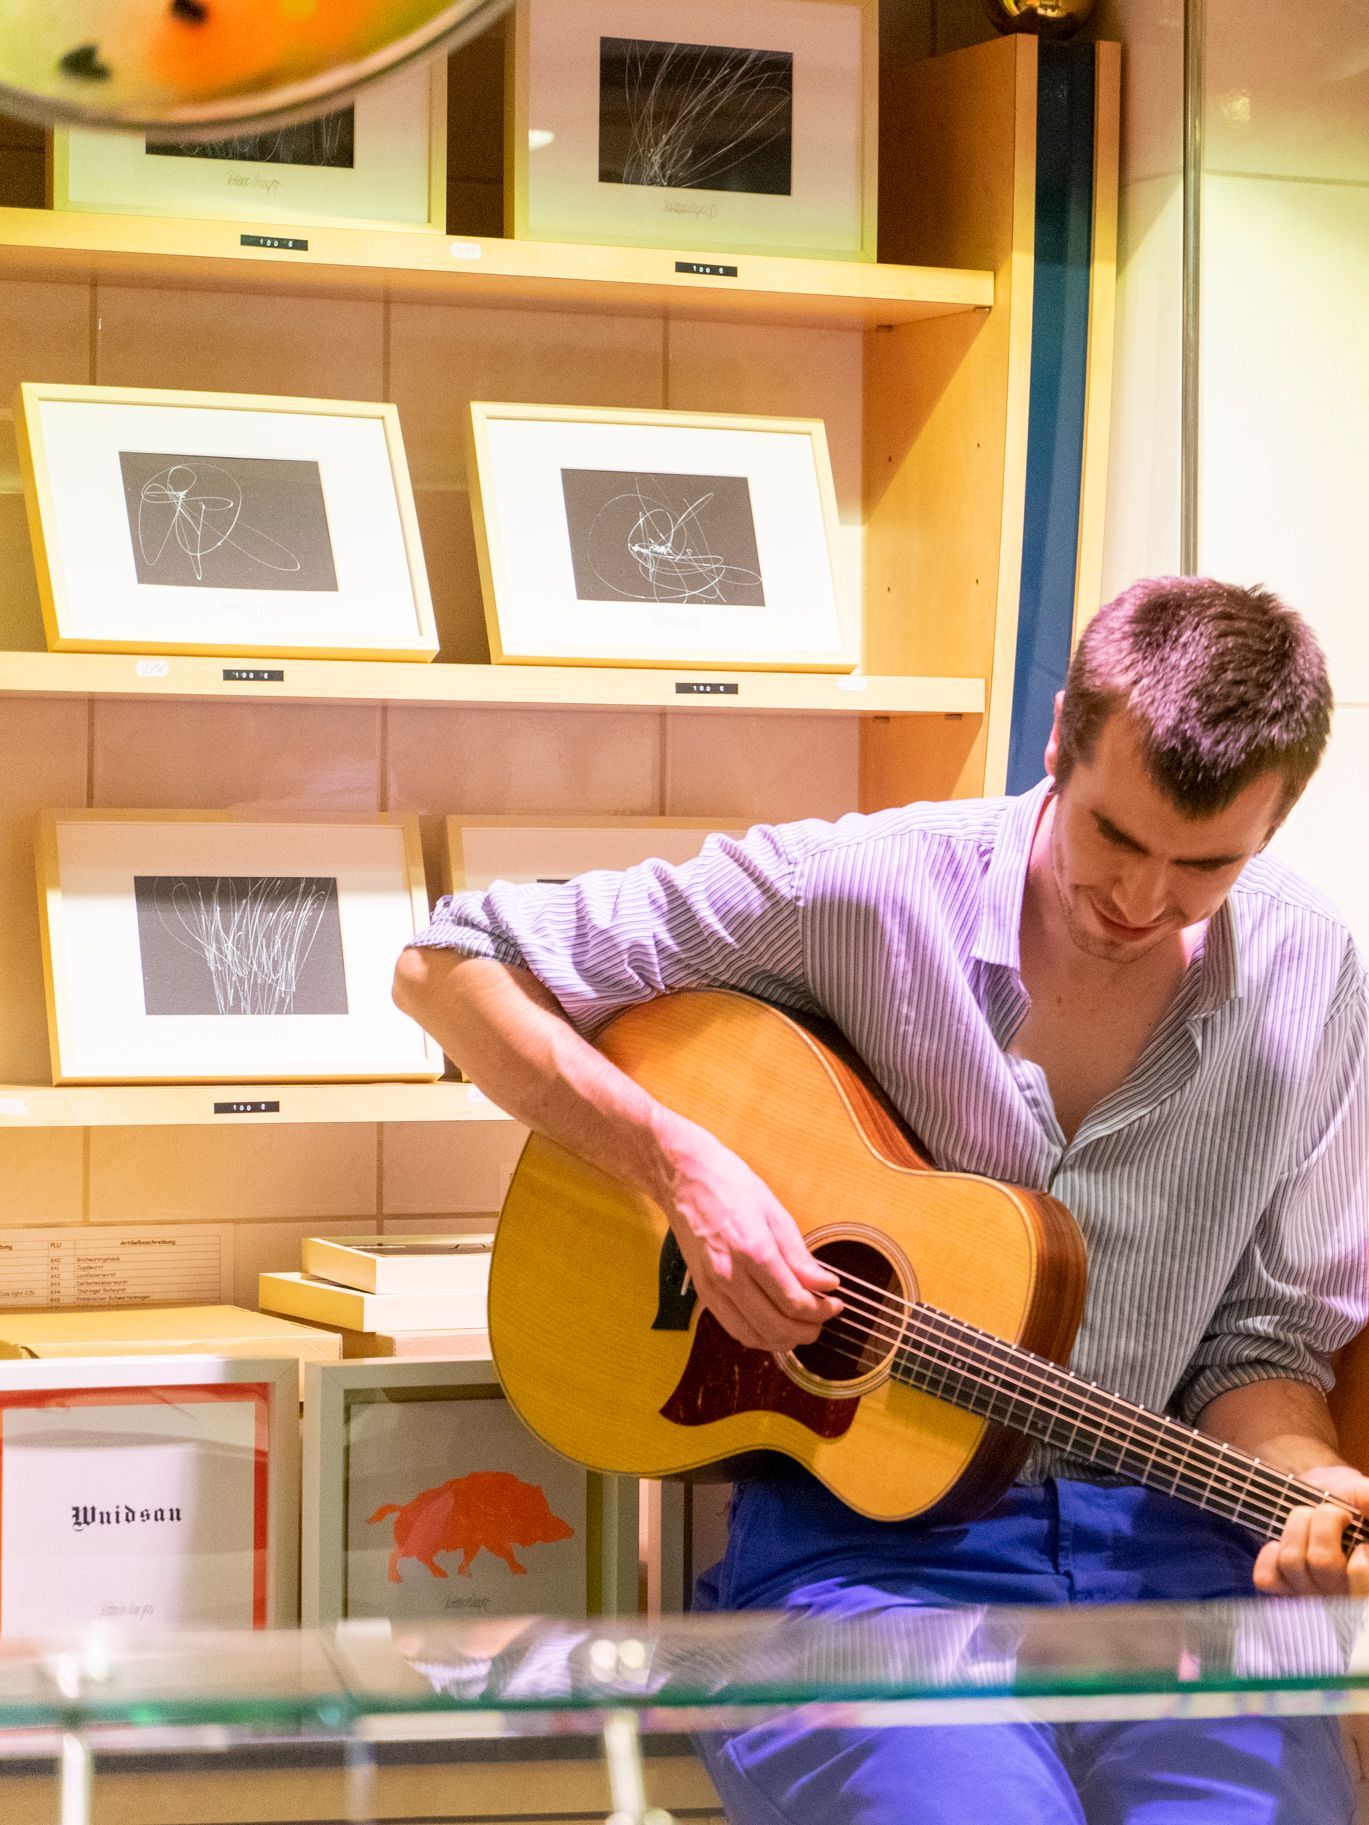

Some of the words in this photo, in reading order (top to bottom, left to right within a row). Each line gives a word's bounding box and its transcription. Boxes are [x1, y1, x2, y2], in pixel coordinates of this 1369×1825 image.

[692, 265, 711, 274] 100
[234, 671, 254, 679] 100
[232, 1103, 252, 1111] 100
